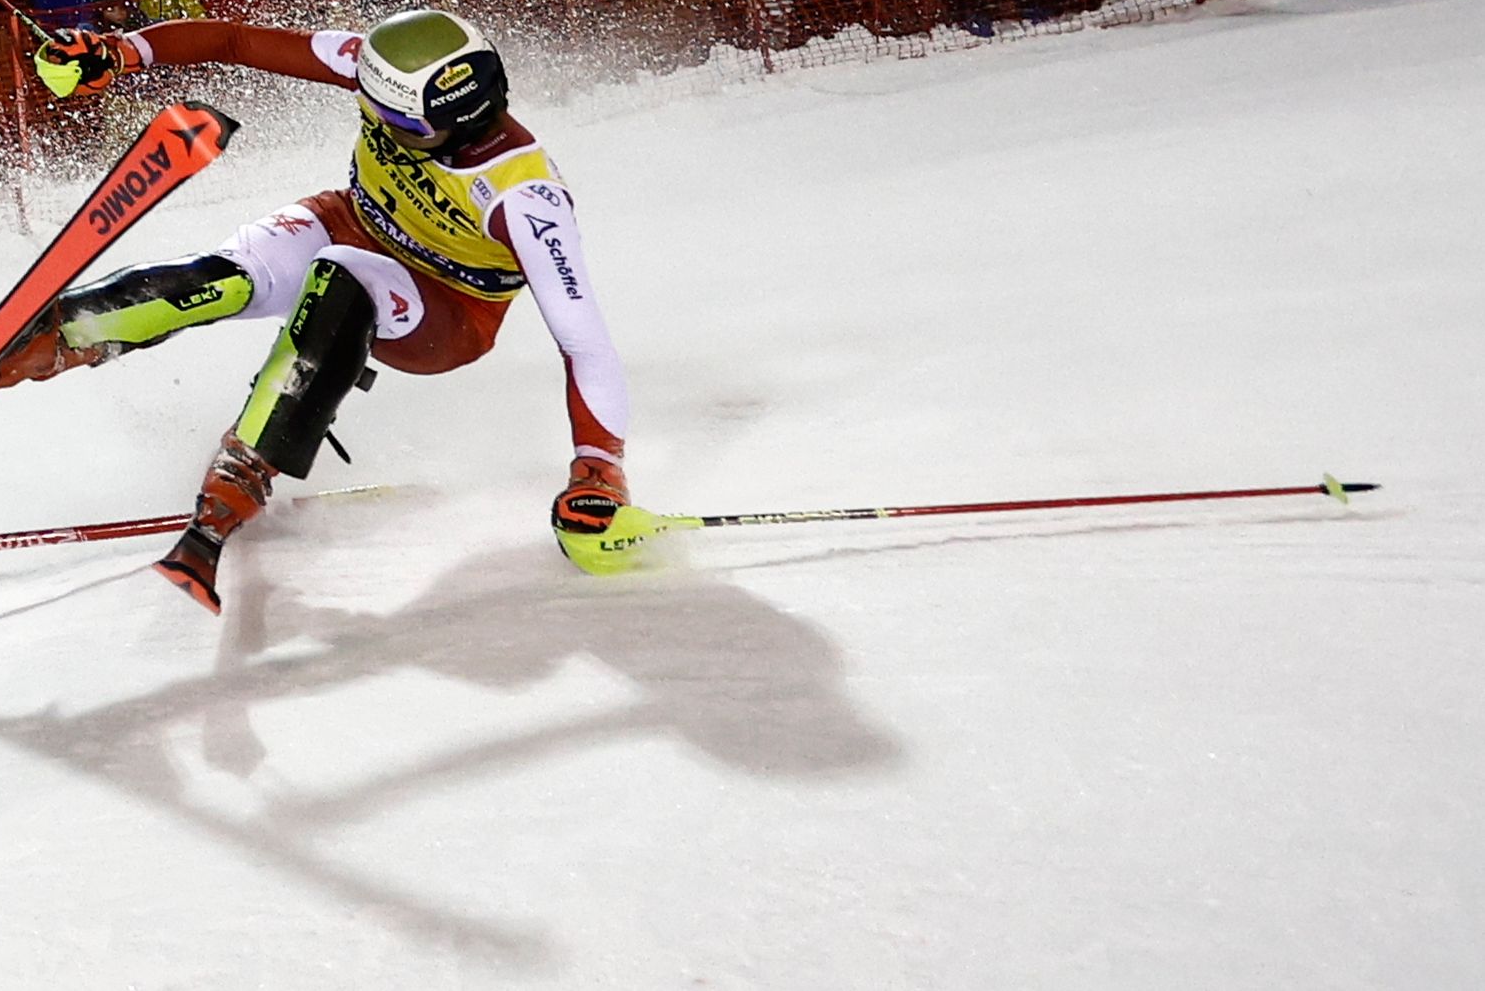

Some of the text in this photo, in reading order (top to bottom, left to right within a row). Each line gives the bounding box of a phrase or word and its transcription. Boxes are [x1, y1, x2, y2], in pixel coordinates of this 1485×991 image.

[430, 80, 478, 108] ATOMIC
[89, 140, 172, 235] ATOMIC
[544, 237, 583, 301] Schöffel
[179, 289, 218, 308] LEKI
[388, 289, 410, 323] A1
[292, 298, 313, 335] LEKI
